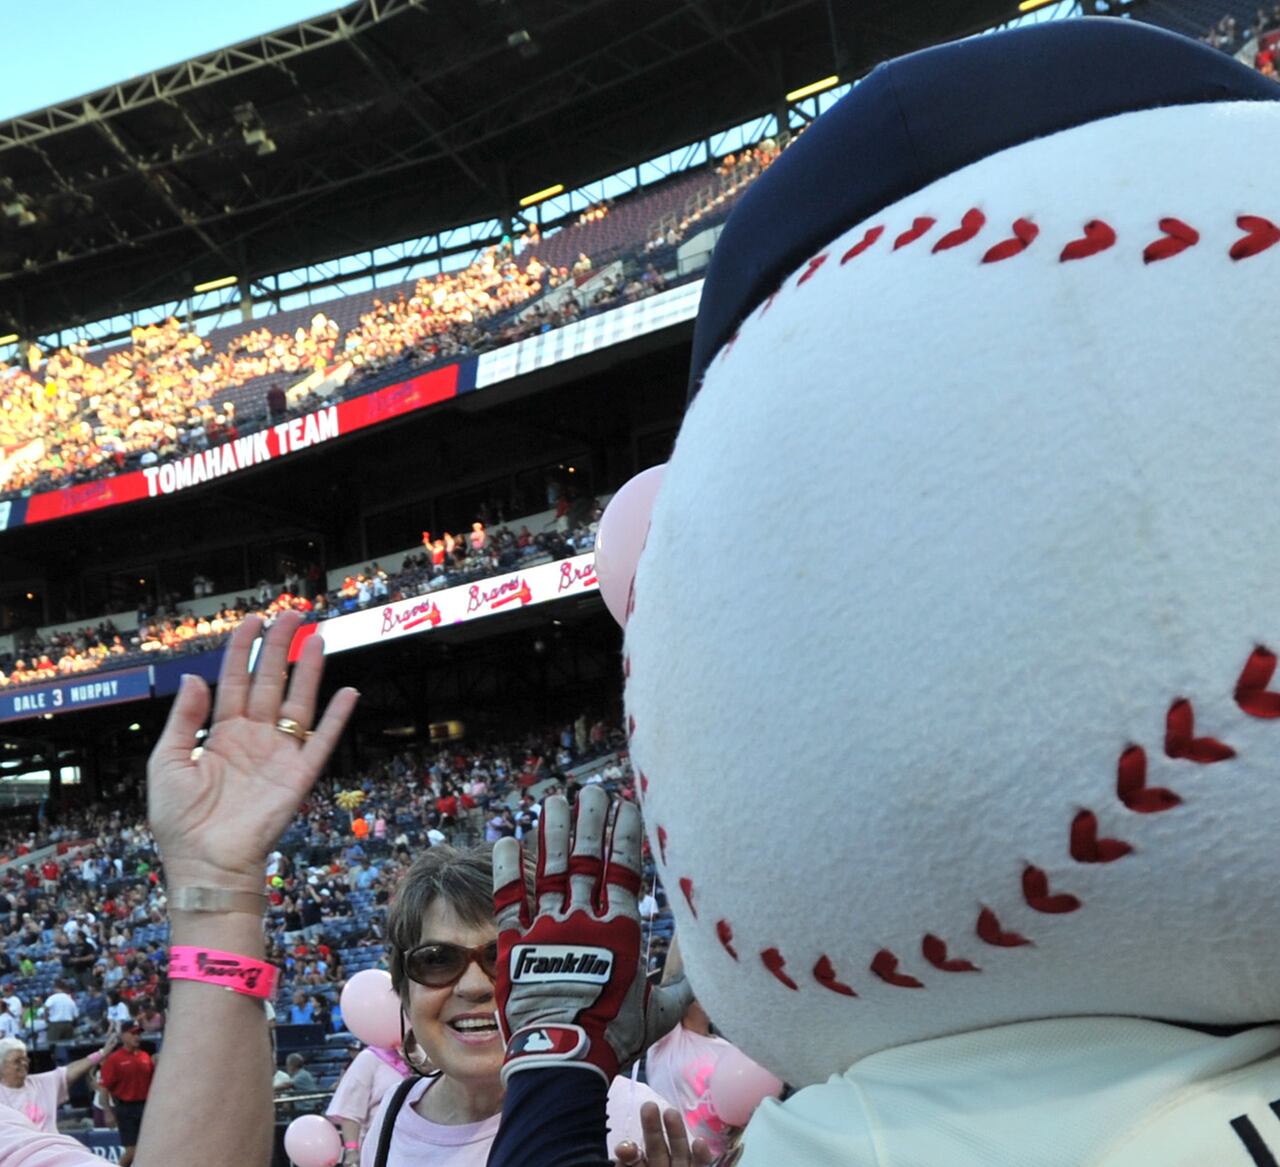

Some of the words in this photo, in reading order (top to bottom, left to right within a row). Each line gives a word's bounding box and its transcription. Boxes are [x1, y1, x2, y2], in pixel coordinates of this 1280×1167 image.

[143, 430, 271, 497] TOMAHAWK
[274, 405, 340, 455] TEAM
[13, 692, 46, 712] DALE
[52, 688, 64, 706] 3
[70, 680, 118, 702] MURPHY
[512, 948, 611, 980] Franklin
